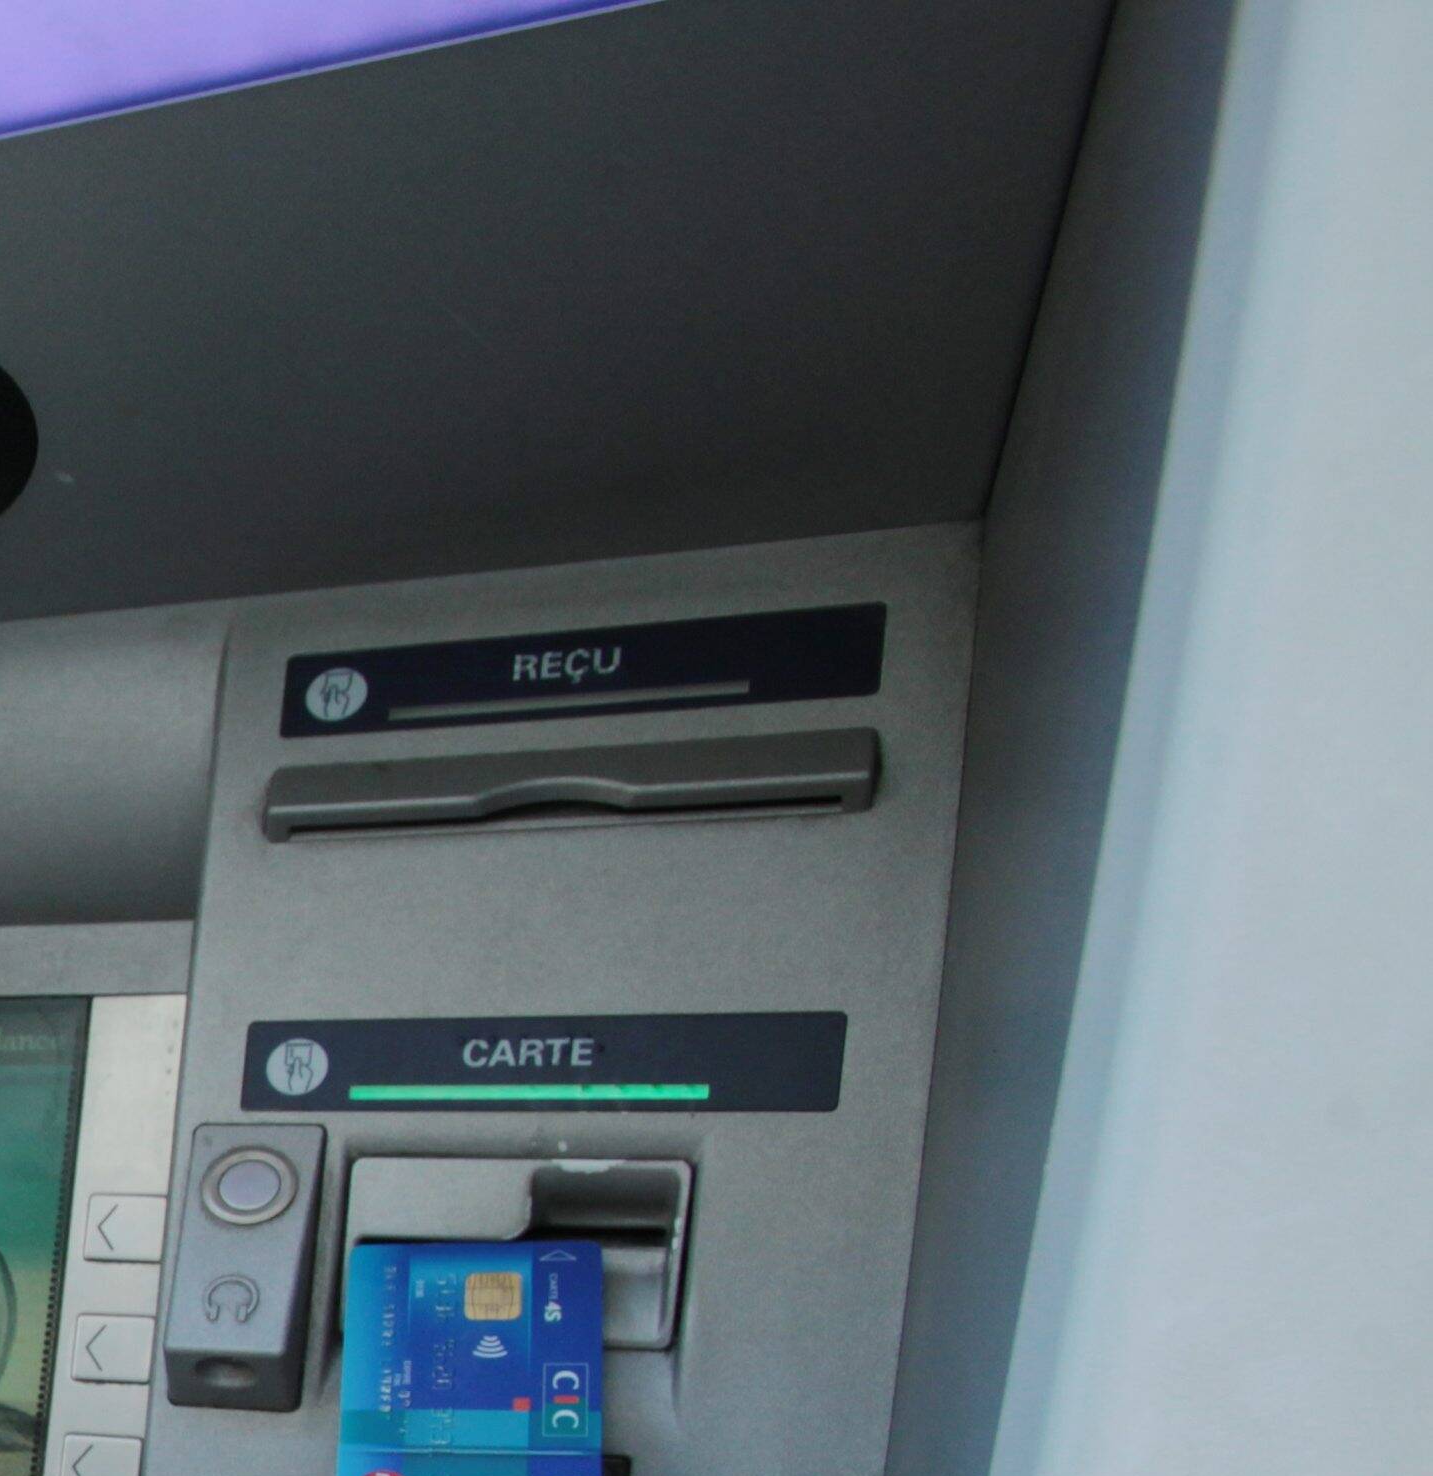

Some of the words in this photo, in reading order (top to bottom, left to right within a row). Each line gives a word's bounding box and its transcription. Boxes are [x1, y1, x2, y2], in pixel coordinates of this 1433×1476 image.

[512, 646, 623, 685] REÇU
[462, 1038, 595, 1070] CARTE
[544, 1300, 562, 1323] 4S
[551, 1369, 580, 1429] CIC
